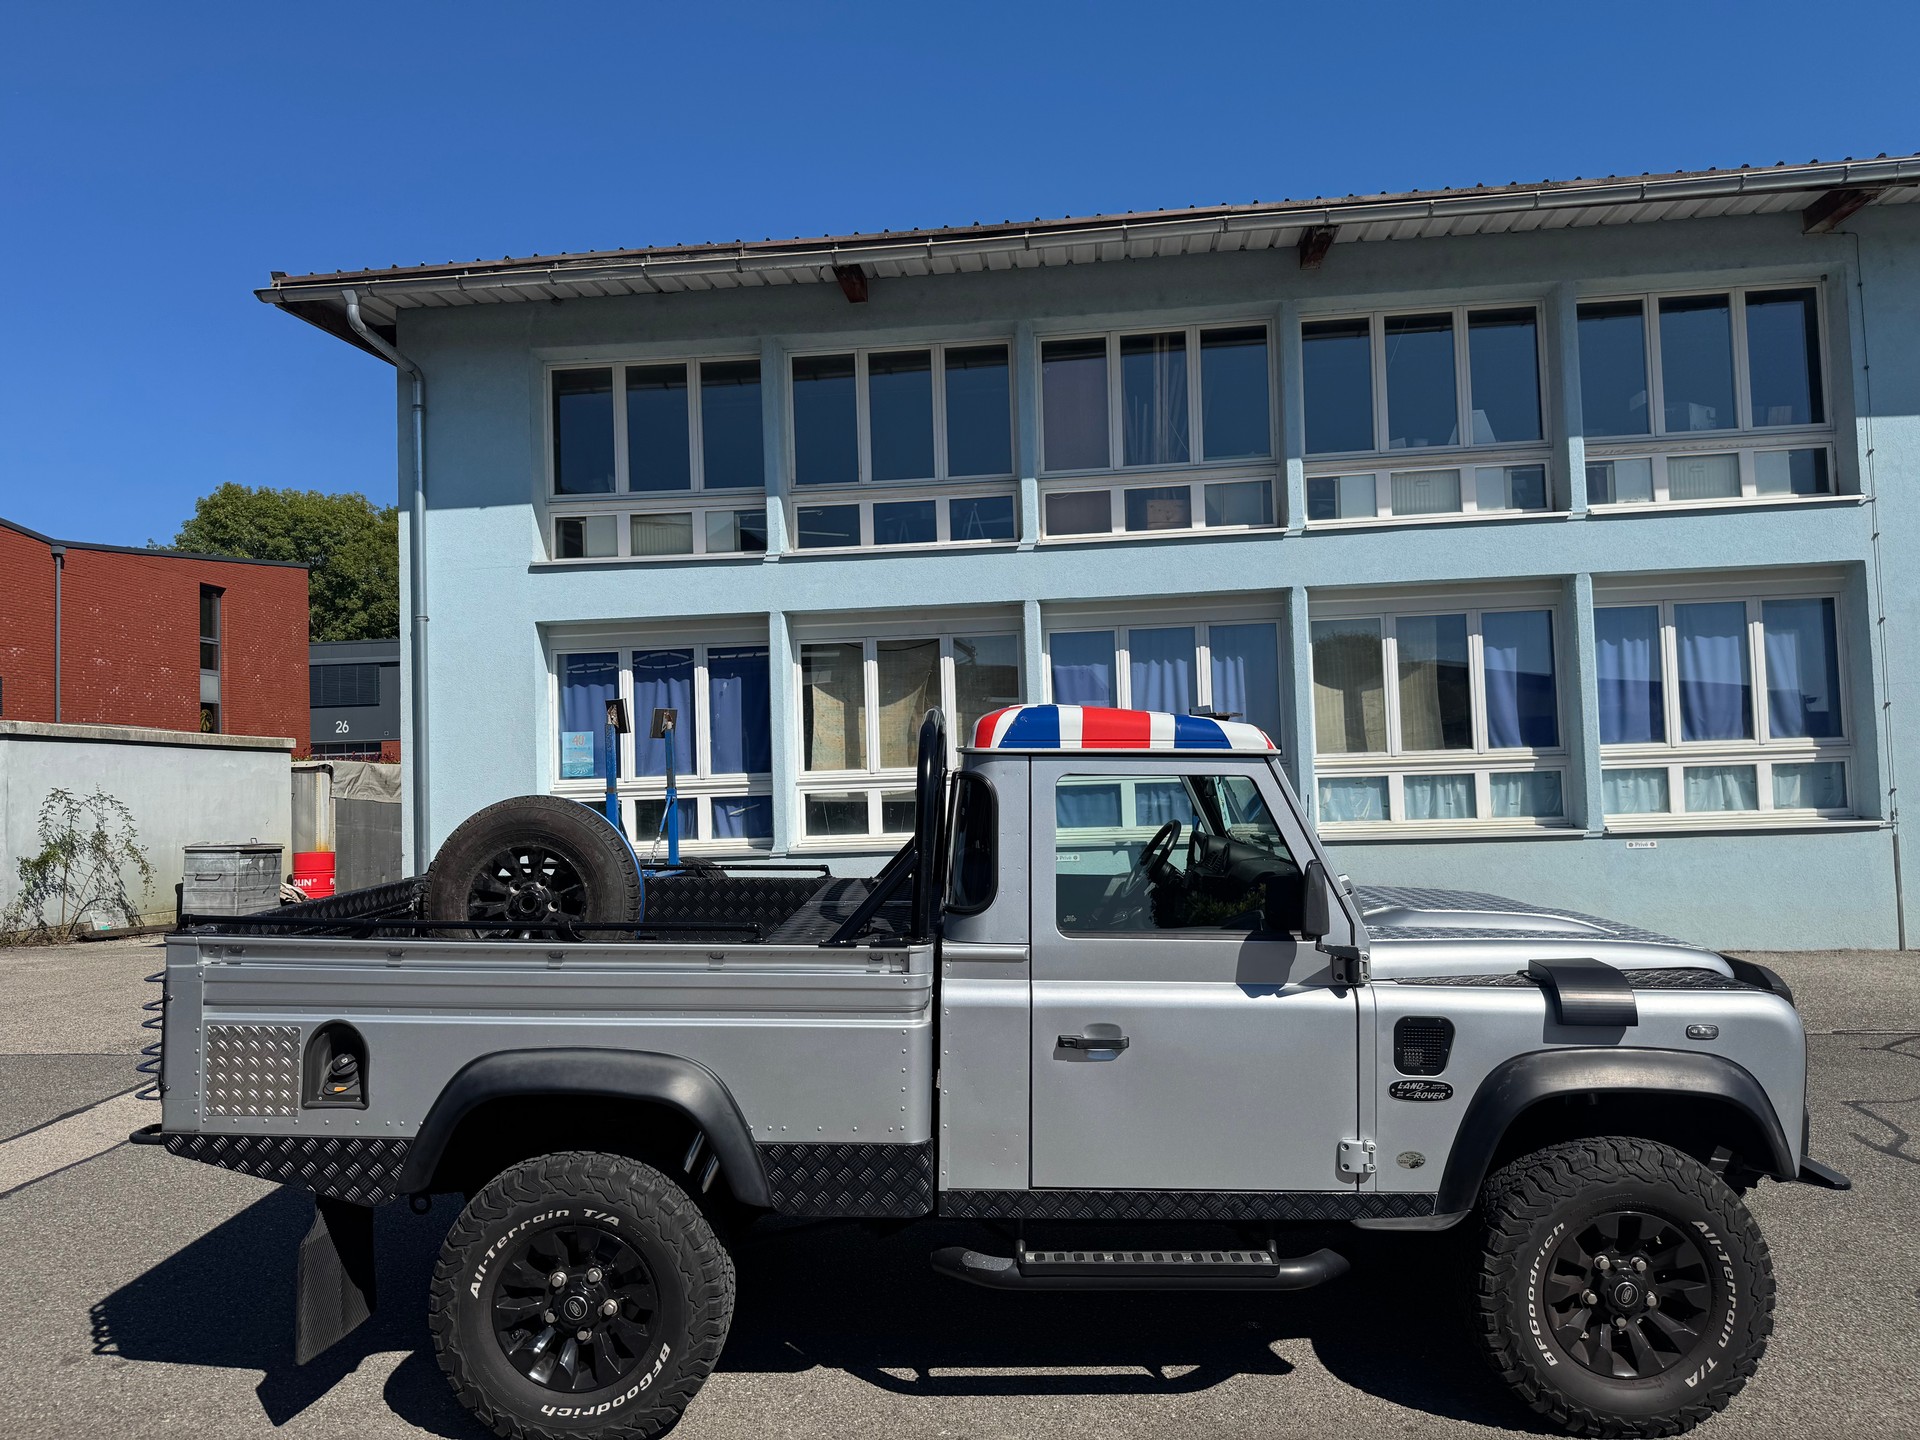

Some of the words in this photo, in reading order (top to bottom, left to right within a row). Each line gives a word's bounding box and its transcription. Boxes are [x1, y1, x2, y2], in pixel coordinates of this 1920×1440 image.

[335, 720, 349, 733] 26
[1397, 1082, 1424, 1090] LAND
[1413, 1091, 1446, 1100] ROVER
[470, 1208, 570, 1299] All-Terrain
[583, 1208, 620, 1227] T/A
[1527, 1221, 1566, 1367] BFGoodrich
[1691, 1220, 1737, 1349] All-Terrain
[540, 1342, 671, 1419] BFGoodrich
[1684, 1356, 1718, 1388] T/A
